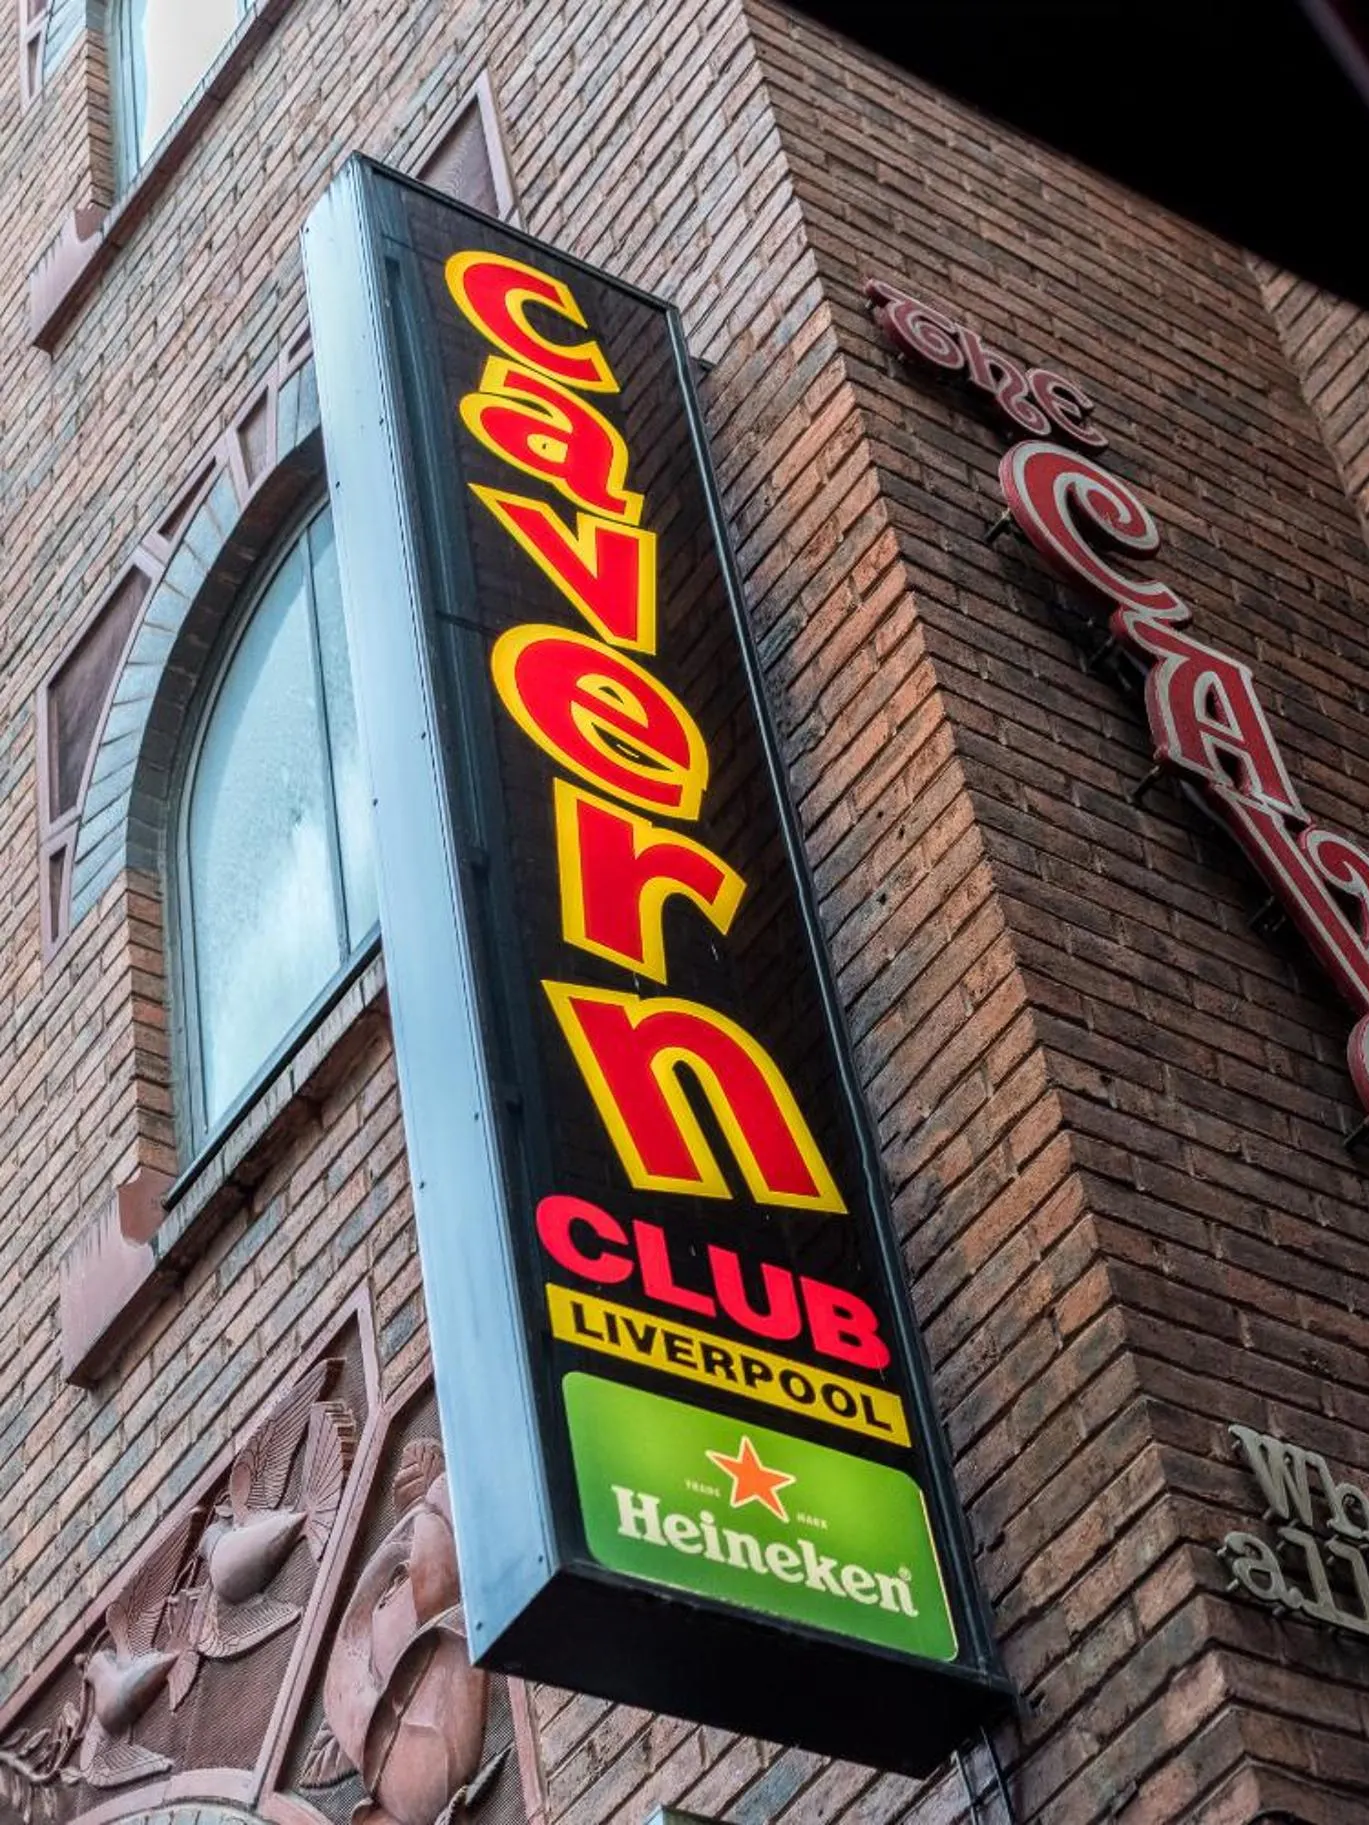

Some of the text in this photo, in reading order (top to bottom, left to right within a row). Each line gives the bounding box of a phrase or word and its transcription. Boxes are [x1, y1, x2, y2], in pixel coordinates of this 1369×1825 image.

[443, 249, 848, 1214] cavern
[536, 1195, 891, 1369] CLUB
[570, 1302, 894, 1432] LIVERPOOL
[610, 1484, 920, 1619] Heineken
